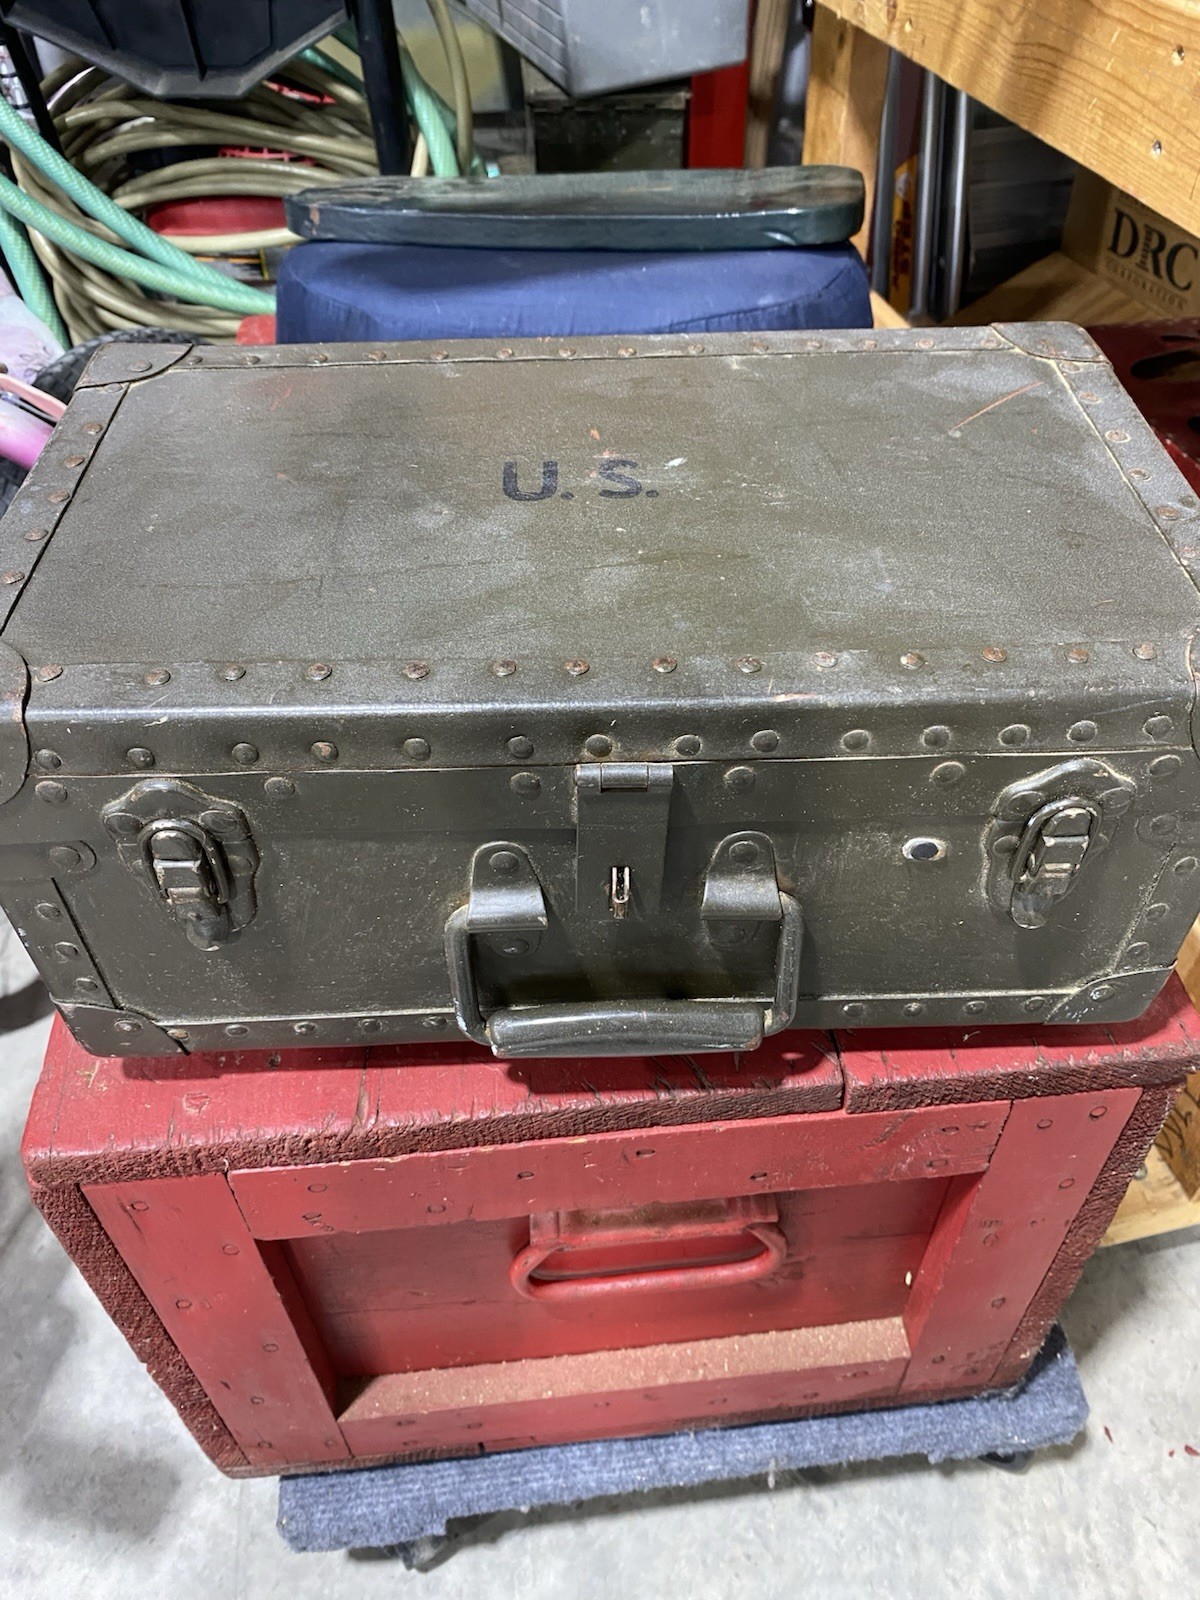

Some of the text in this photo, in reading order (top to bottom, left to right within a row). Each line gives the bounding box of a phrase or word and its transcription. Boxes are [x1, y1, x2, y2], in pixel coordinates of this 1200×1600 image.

[1108, 207, 1199, 291] DRC
[502, 458, 660, 501] U. S.
